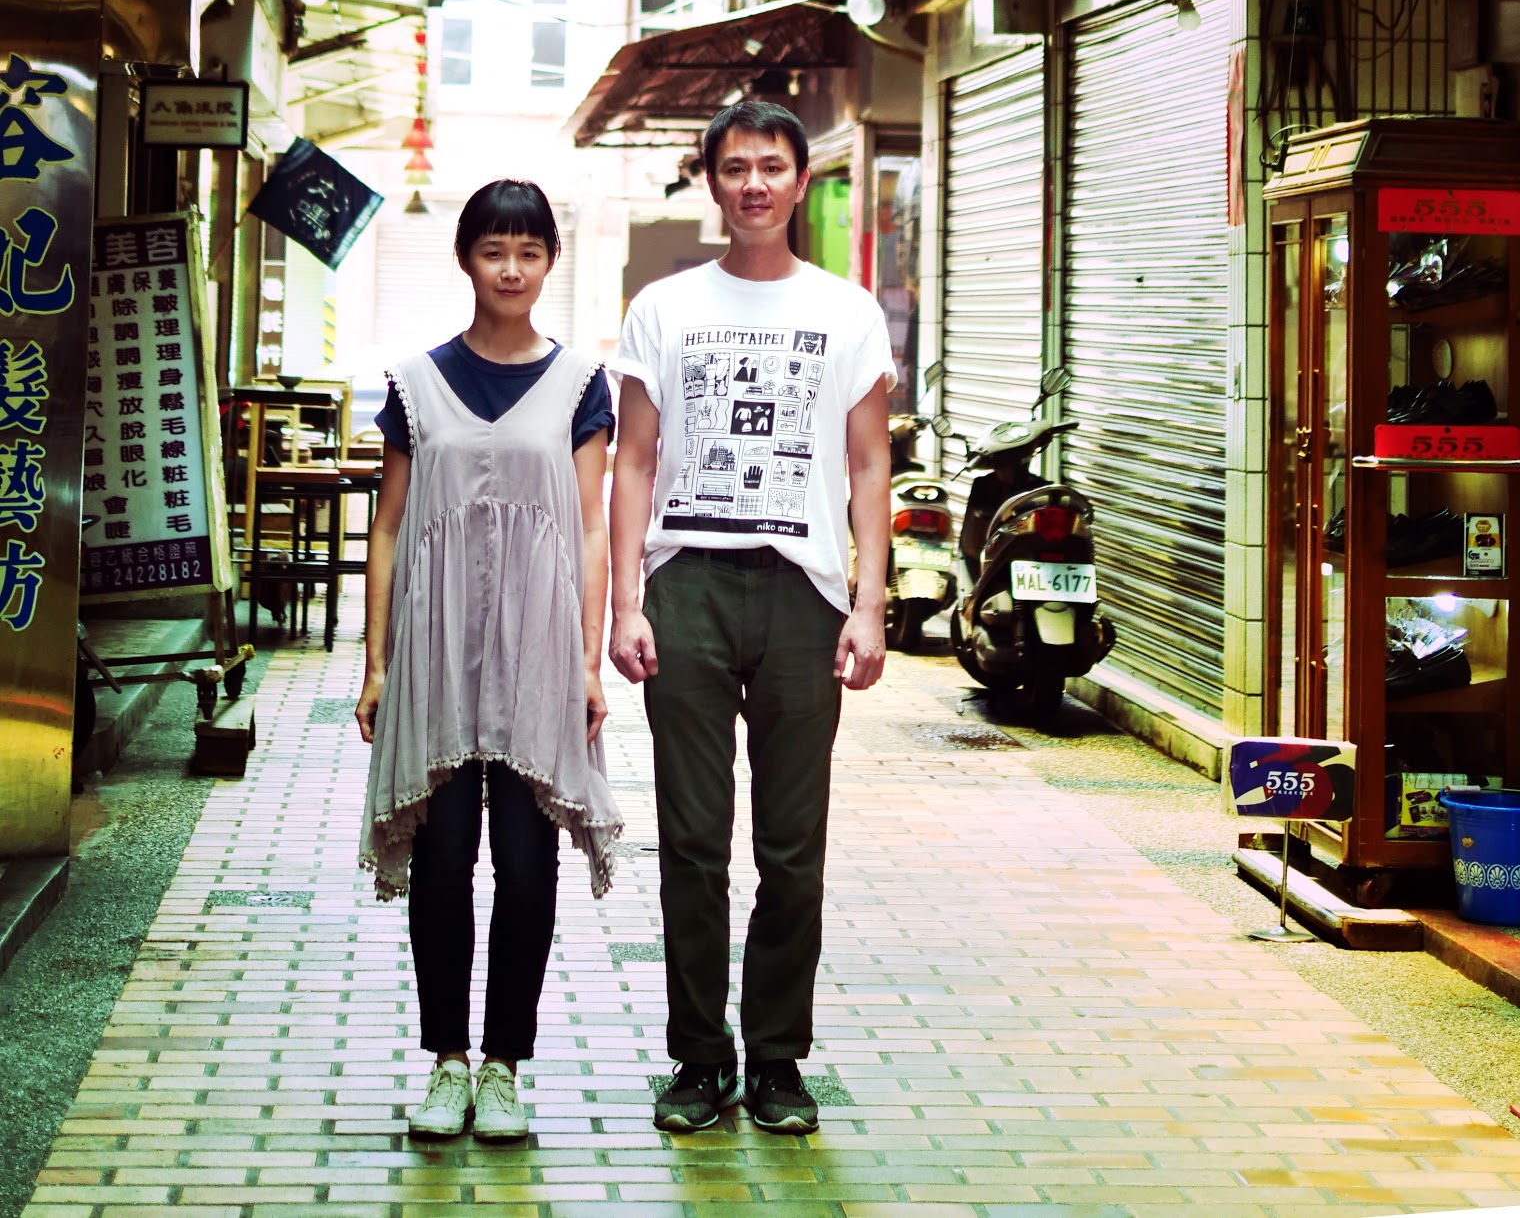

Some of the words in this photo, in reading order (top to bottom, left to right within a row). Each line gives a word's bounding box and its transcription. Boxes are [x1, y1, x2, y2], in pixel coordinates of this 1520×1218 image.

[1414, 198, 1487, 217] 555
[91, 228, 179, 268] 美容
[1411, 436, 1485, 453] 555
[756, 522, 775, 532] niko
[1266, 771, 1315, 791] 555
